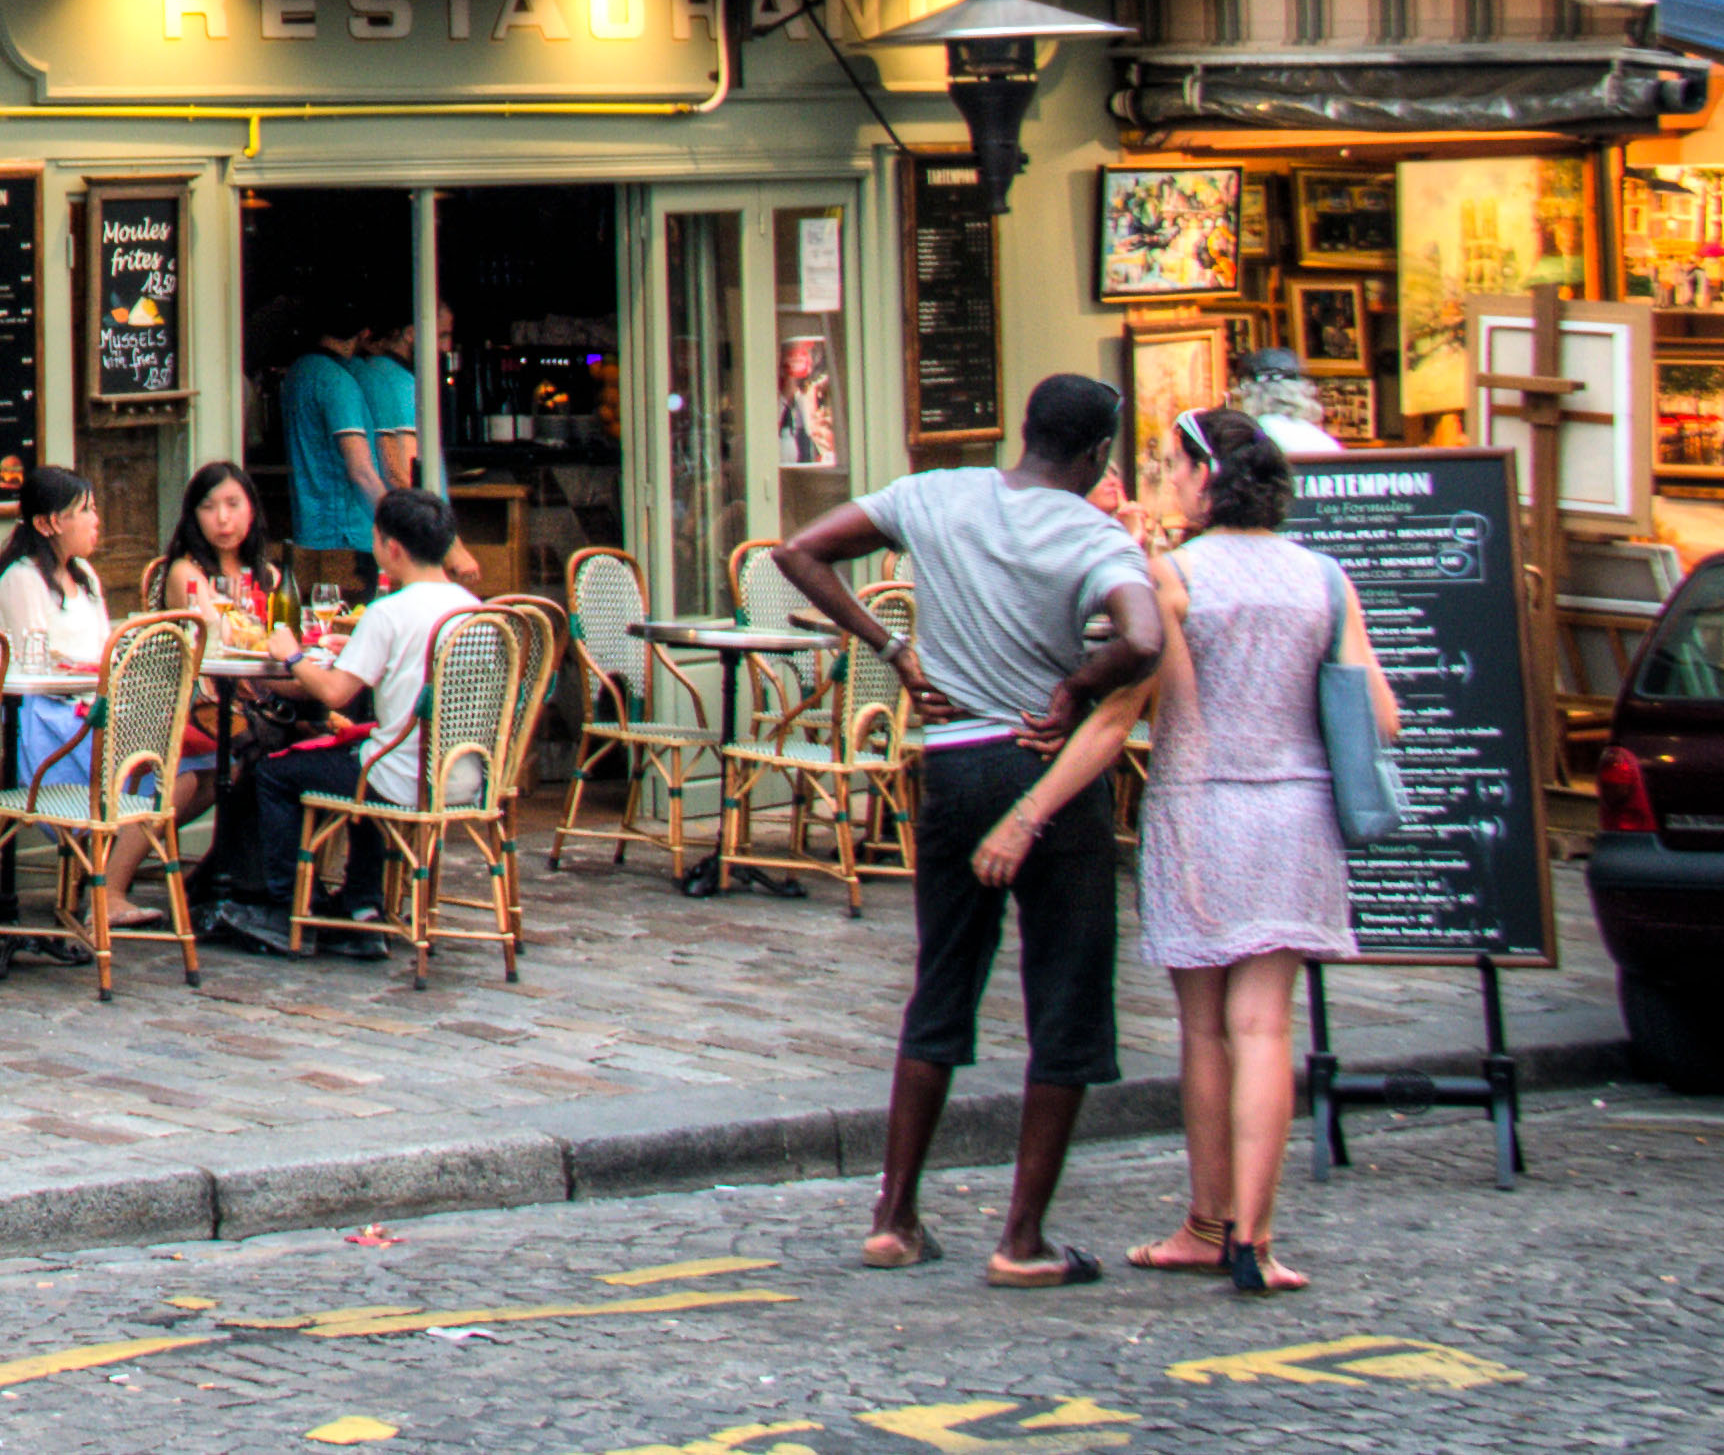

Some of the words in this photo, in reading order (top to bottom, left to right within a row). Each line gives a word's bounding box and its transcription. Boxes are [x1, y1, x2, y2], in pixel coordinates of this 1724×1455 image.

[103, 216, 173, 244] Moules
[111, 247, 164, 277] frites
[1293, 472, 1434, 499] TARTEMPION
